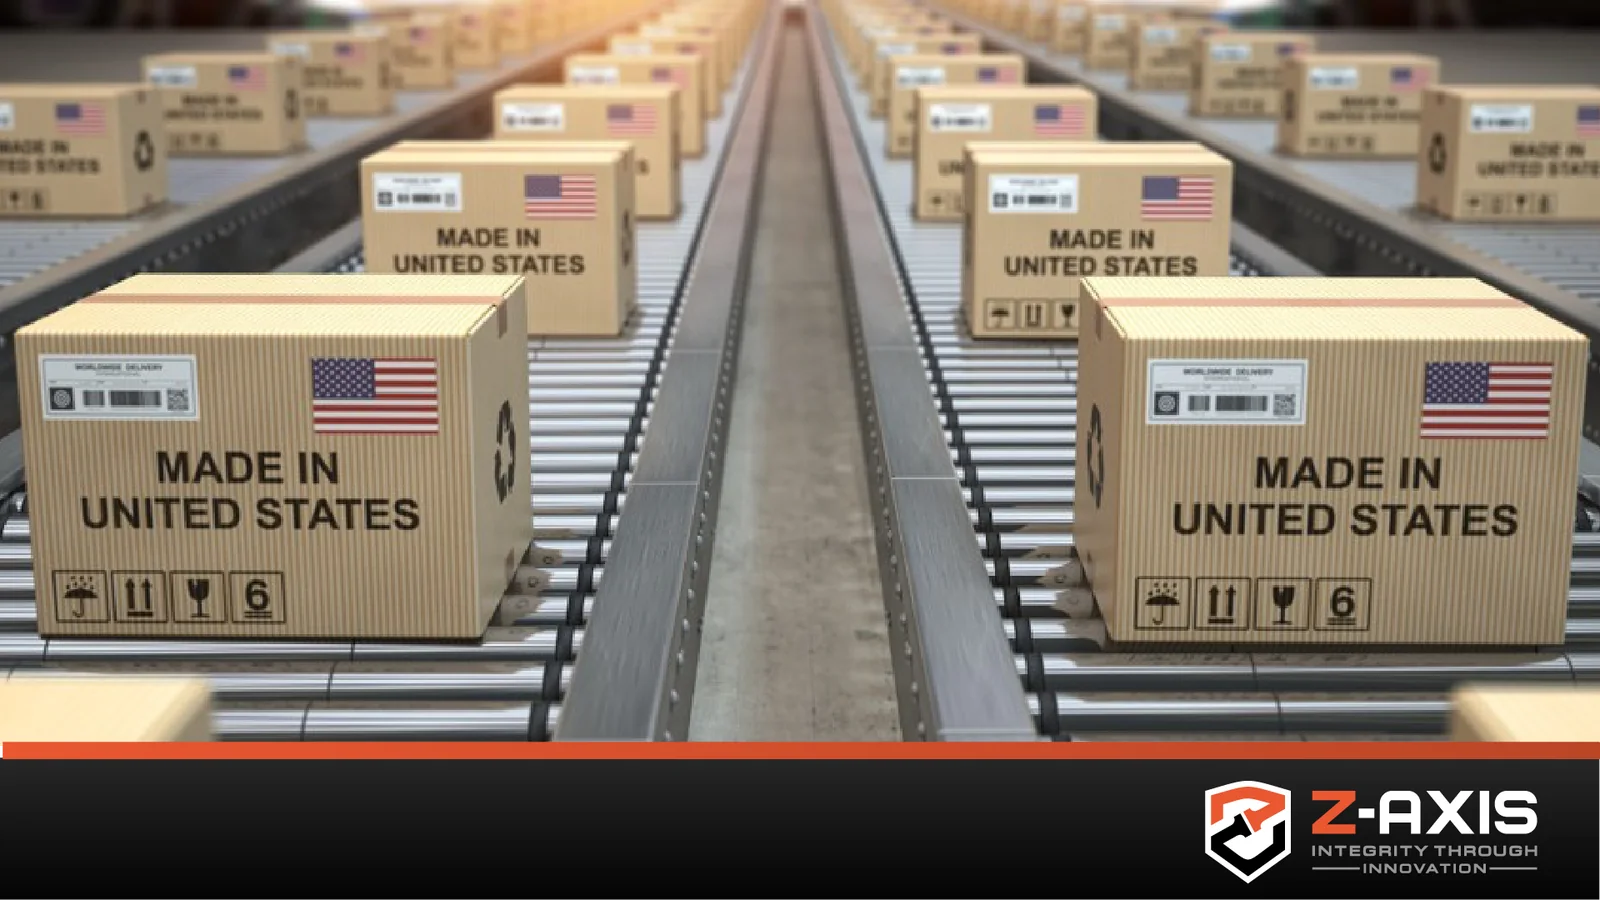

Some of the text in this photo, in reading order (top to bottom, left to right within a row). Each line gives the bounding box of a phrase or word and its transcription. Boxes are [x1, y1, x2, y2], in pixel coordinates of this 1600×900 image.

[1510, 143, 1585, 157] MADE IN
[438, 228, 540, 247] MADE IN
[1050, 230, 1154, 249] MADE IN
[394, 254, 585, 275] UNITED STATES
[1005, 257, 1197, 277] UNITED STATES
[157, 451, 339, 484] MADE IN
[1256, 457, 1442, 489] MADE IN
[82, 497, 420, 530] UNITED STATES
[1174, 503, 1518, 537] UNITED STATES
[245, 579, 269, 611] 6
[1331, 587, 1355, 617] 6
